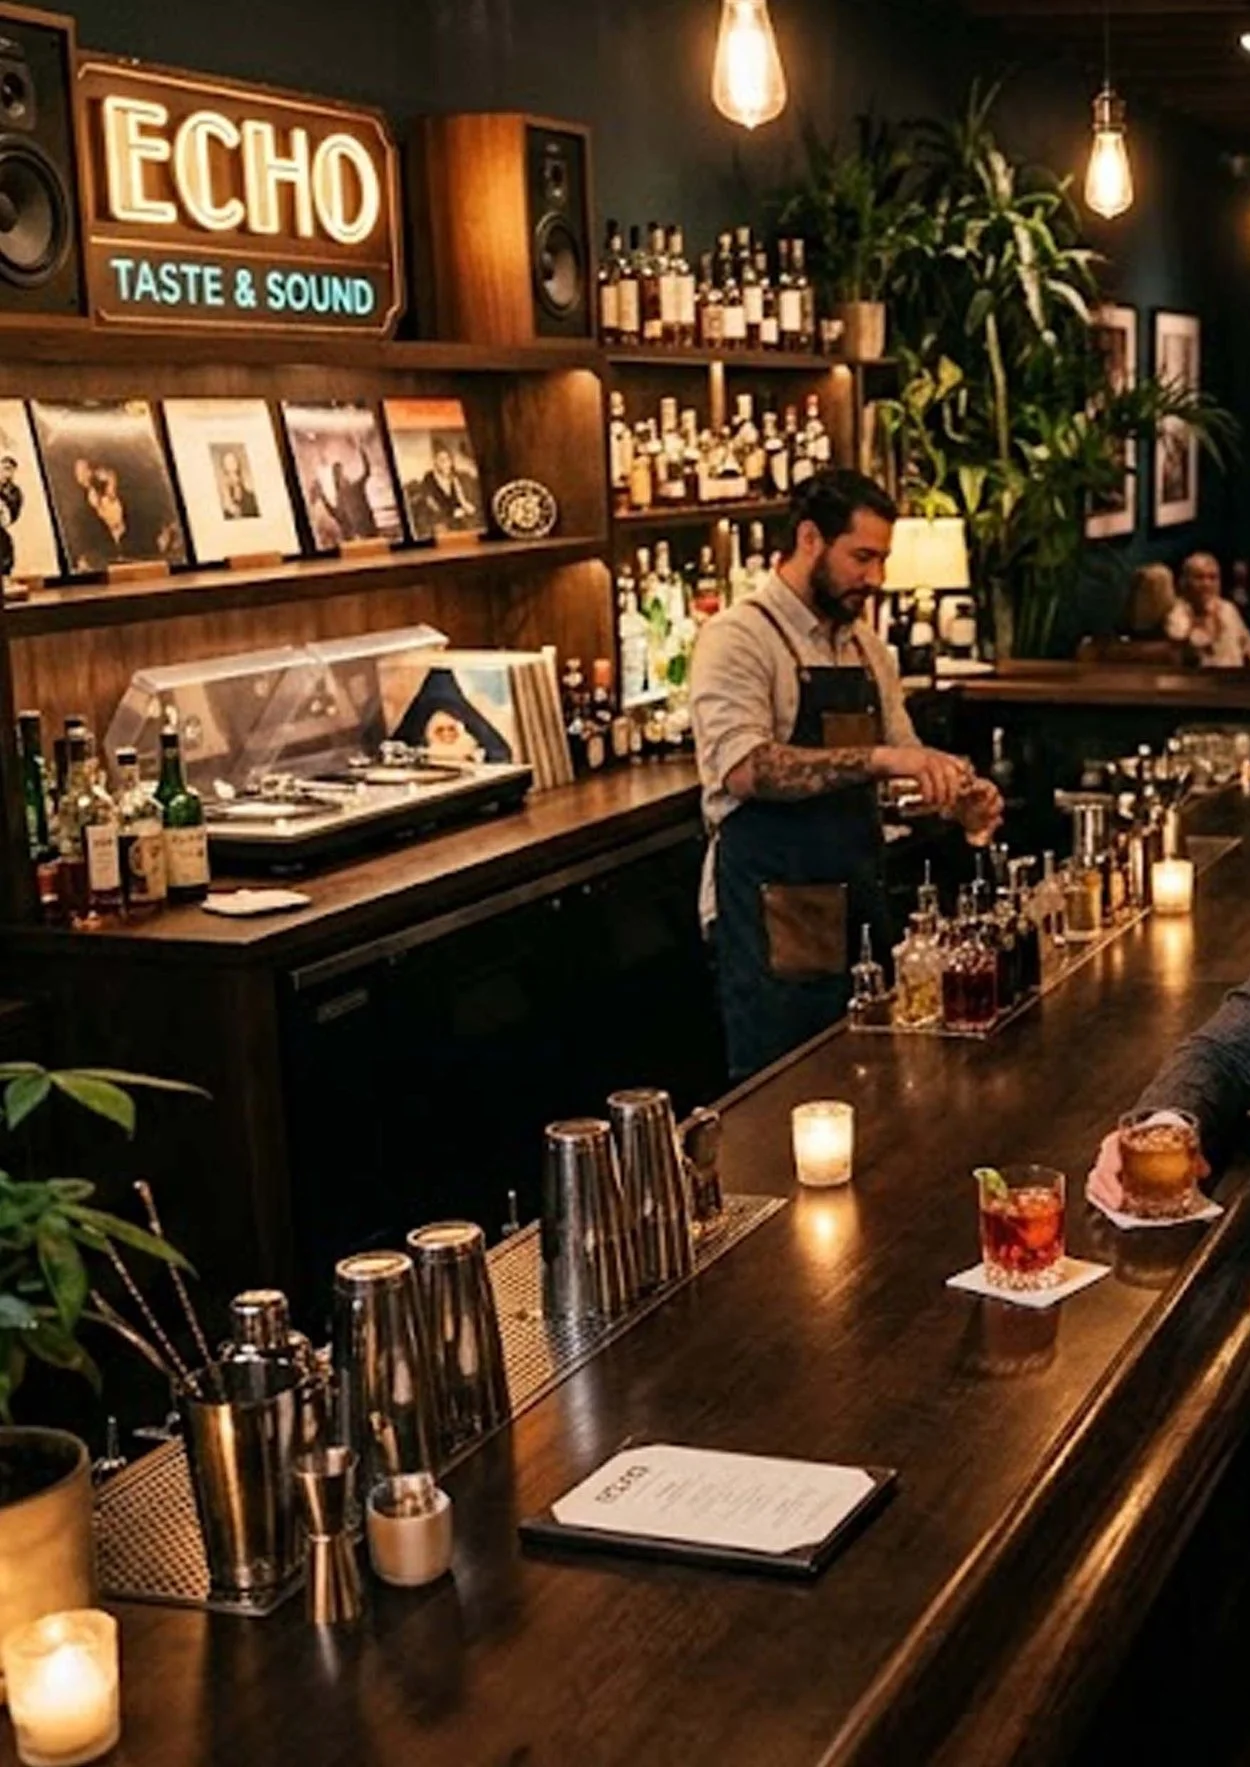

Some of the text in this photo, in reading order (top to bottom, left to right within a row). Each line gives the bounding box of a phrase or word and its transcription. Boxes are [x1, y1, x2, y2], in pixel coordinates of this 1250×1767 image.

[103, 95, 380, 244] ECHO
[110, 258, 374, 315] TASTE & SOUND
